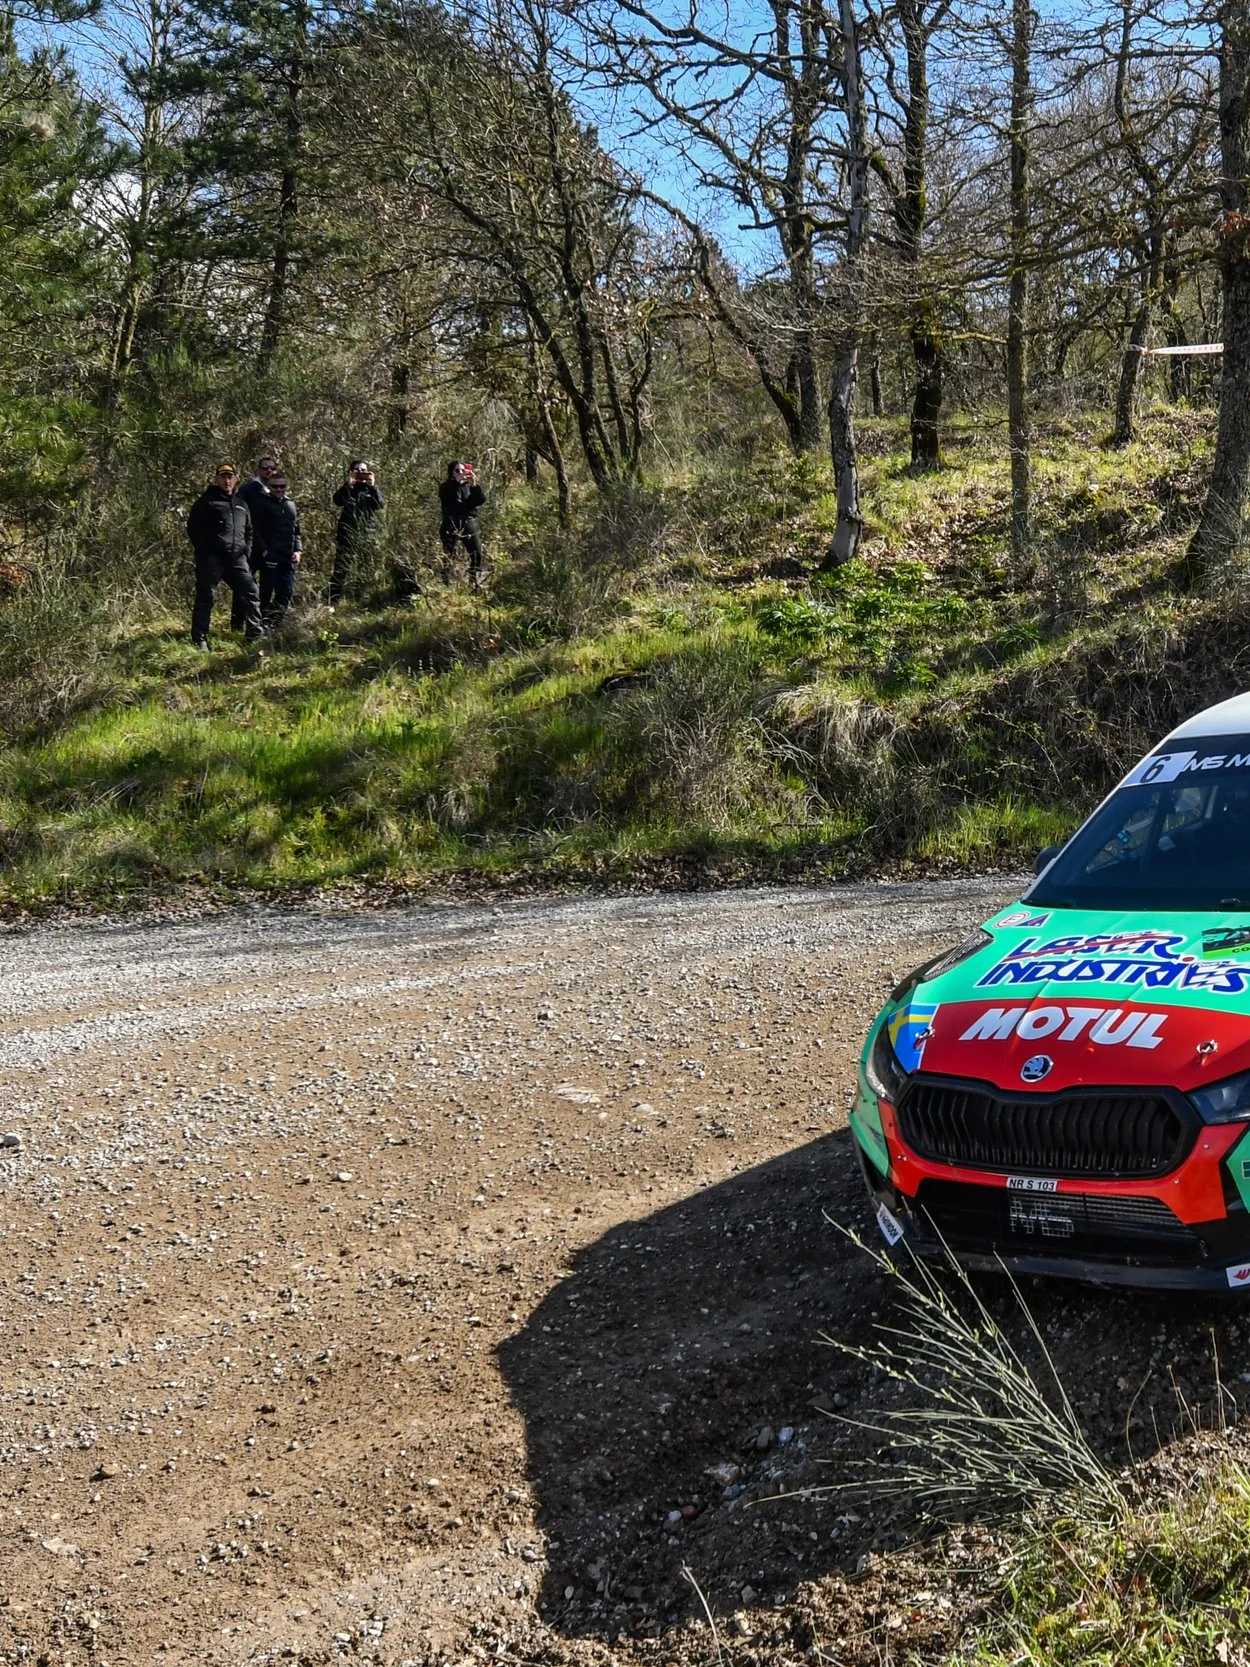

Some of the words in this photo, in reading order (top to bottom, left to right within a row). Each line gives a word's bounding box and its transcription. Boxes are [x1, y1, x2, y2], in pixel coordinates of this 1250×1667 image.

[1140, 755, 1172, 784] 6
[1005, 934, 1184, 960] LASER
[958, 1006, 1169, 1050] MOTUL
[1009, 1179, 1024, 1188] NR
[1027, 1180, 1034, 1189] S
[1038, 1181, 1055, 1190] 103
